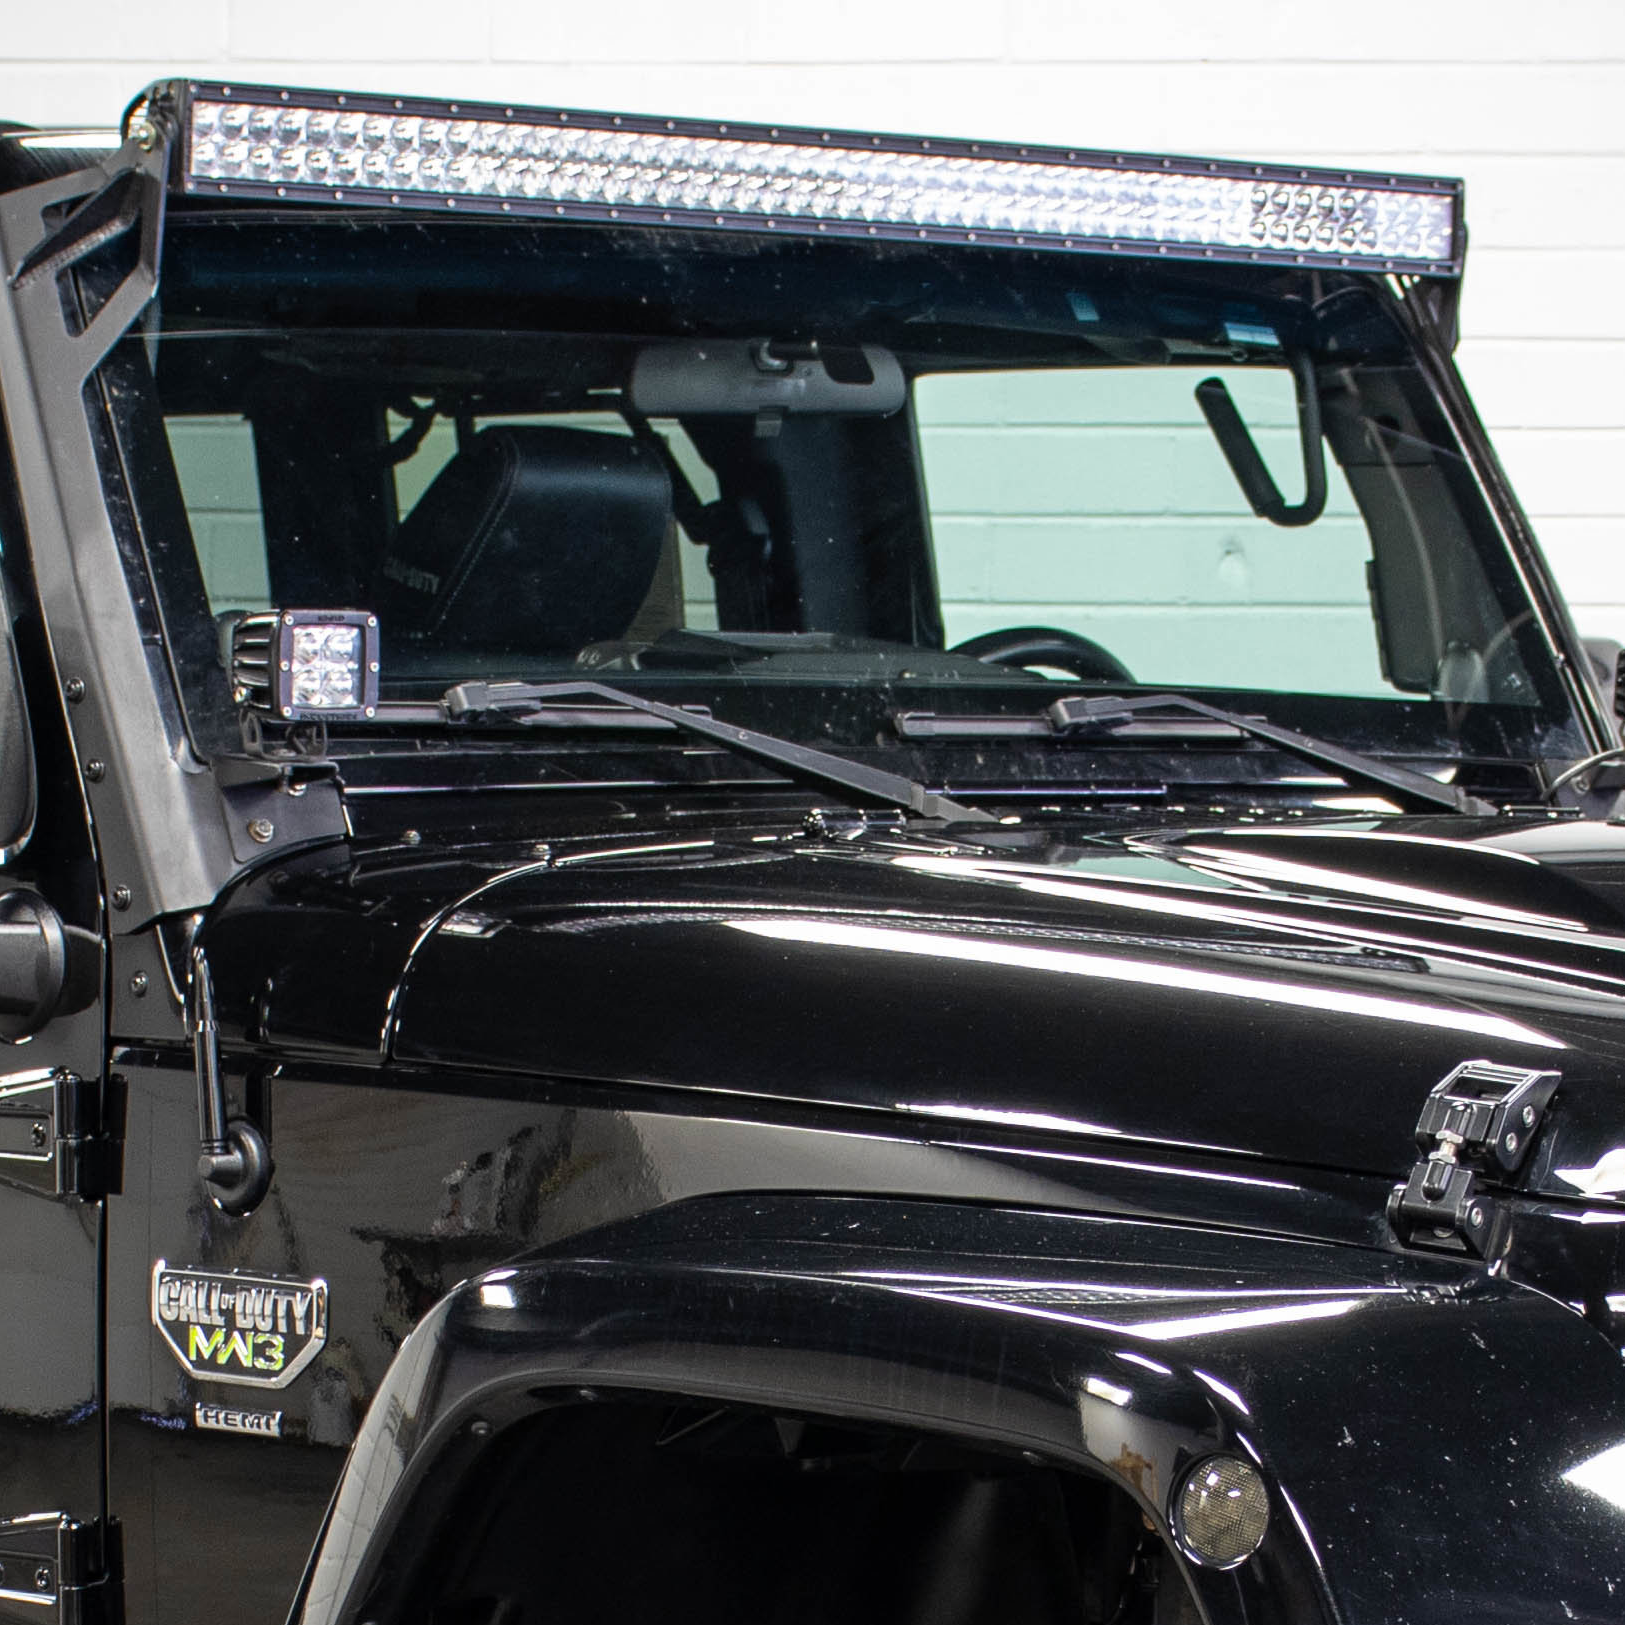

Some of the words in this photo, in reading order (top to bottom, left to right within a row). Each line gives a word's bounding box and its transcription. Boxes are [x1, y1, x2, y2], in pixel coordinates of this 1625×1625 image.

[159, 1277, 225, 1326] CALL
[221, 1293, 236, 1310] OF
[235, 1285, 312, 1335] DUTY
[188, 1325, 285, 1371] MW3
[202, 1408, 273, 1432] HEMI
